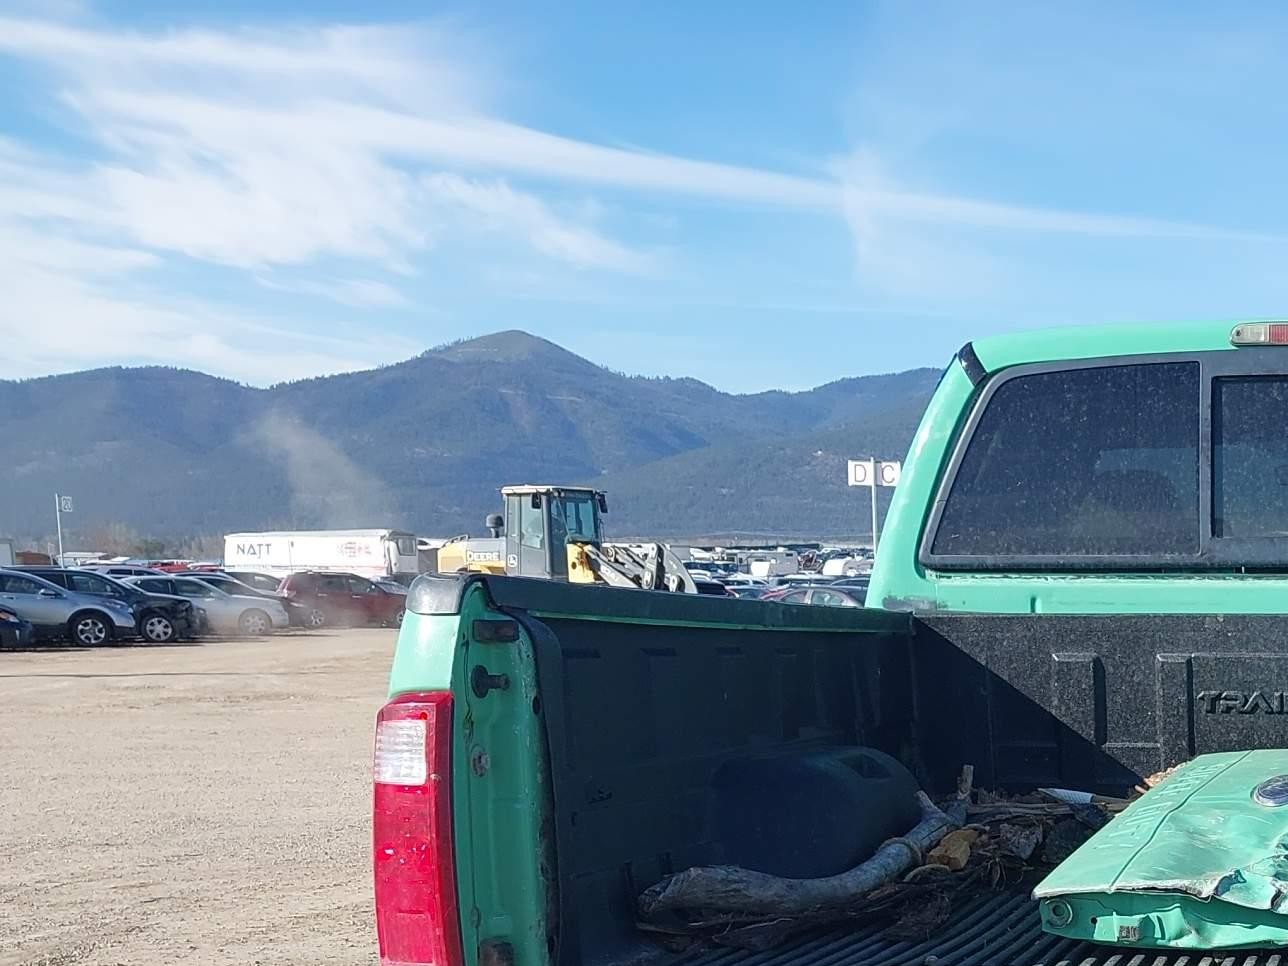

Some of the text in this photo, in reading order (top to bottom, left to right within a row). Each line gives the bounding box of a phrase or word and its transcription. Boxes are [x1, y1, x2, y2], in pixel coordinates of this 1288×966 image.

[853, 463, 867, 483] D
[881, 464, 896, 484] C
[236, 543, 272, 559] NATT
[466, 550, 500, 561] DEERE
